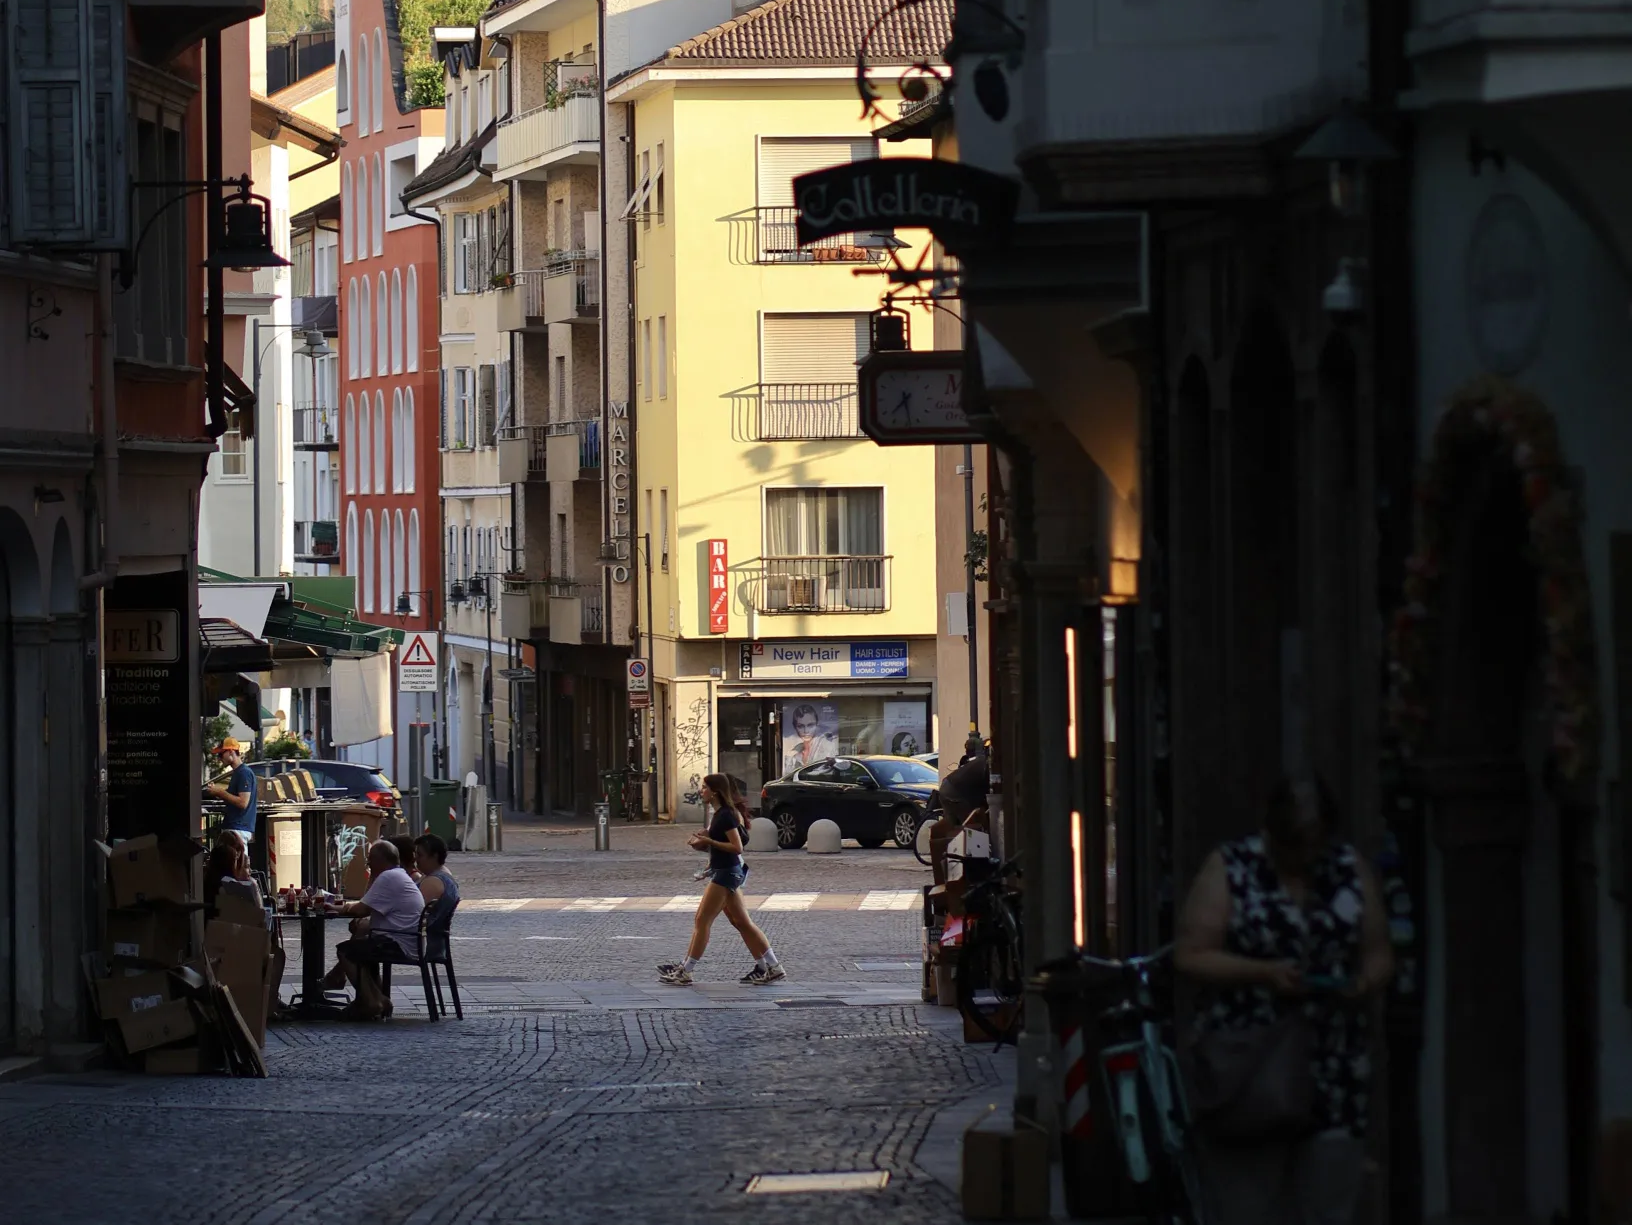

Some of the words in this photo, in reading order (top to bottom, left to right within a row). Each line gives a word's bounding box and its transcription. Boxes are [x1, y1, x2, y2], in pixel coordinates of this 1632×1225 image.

[608, 401, 629, 583] MARCELLO
[712, 541, 726, 589] BAR
[105, 619, 165, 652] FER
[773, 647, 805, 660] New
[811, 647, 840, 660] Hair
[855, 648, 874, 658] HAIR
[876, 648, 903, 658] STILIST
[742, 644, 751, 678] SALON
[114, 666, 169, 678] Tradition
[792, 663, 822, 674] Team
[107, 680, 160, 691] radizione
